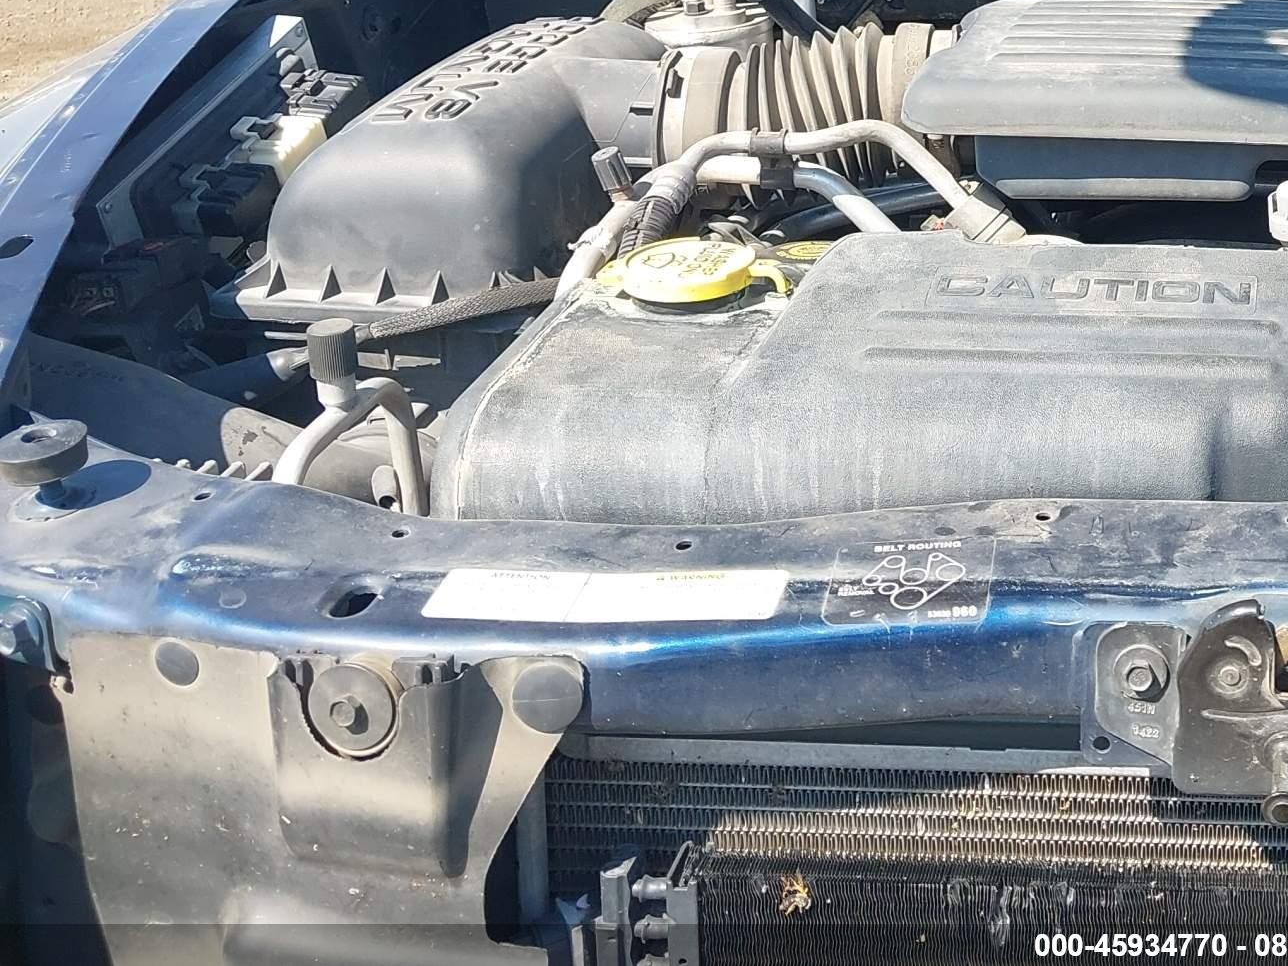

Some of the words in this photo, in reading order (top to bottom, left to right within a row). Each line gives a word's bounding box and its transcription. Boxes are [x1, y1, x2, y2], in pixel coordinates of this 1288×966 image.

[936, 273, 1251, 305] CAUTION
[874, 544, 905, 552] BELT
[908, 541, 961, 550] ROUTING
[952, 606, 977, 617] 960
